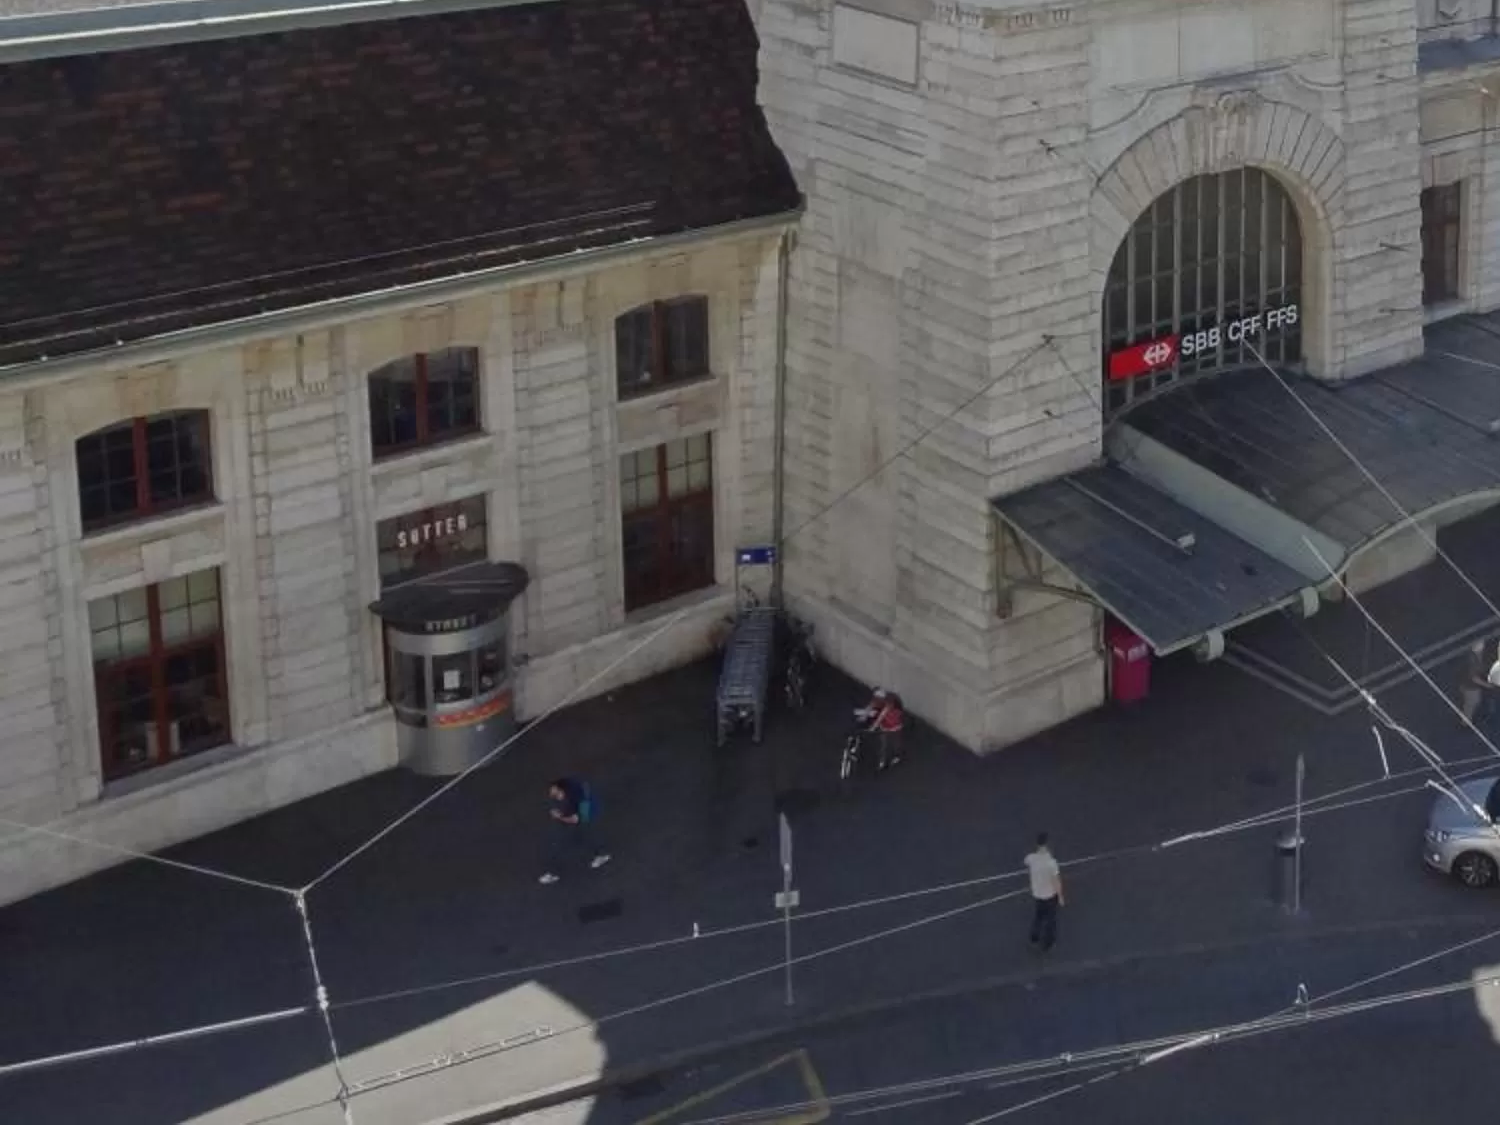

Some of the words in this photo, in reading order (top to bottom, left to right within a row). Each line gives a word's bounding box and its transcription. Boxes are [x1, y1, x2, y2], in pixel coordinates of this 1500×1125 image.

[1181, 326, 1221, 355] SBB
[1228, 315, 1262, 342] CFF
[1266, 304, 1298, 331] FFS
[397, 514, 467, 548] SUTTER
